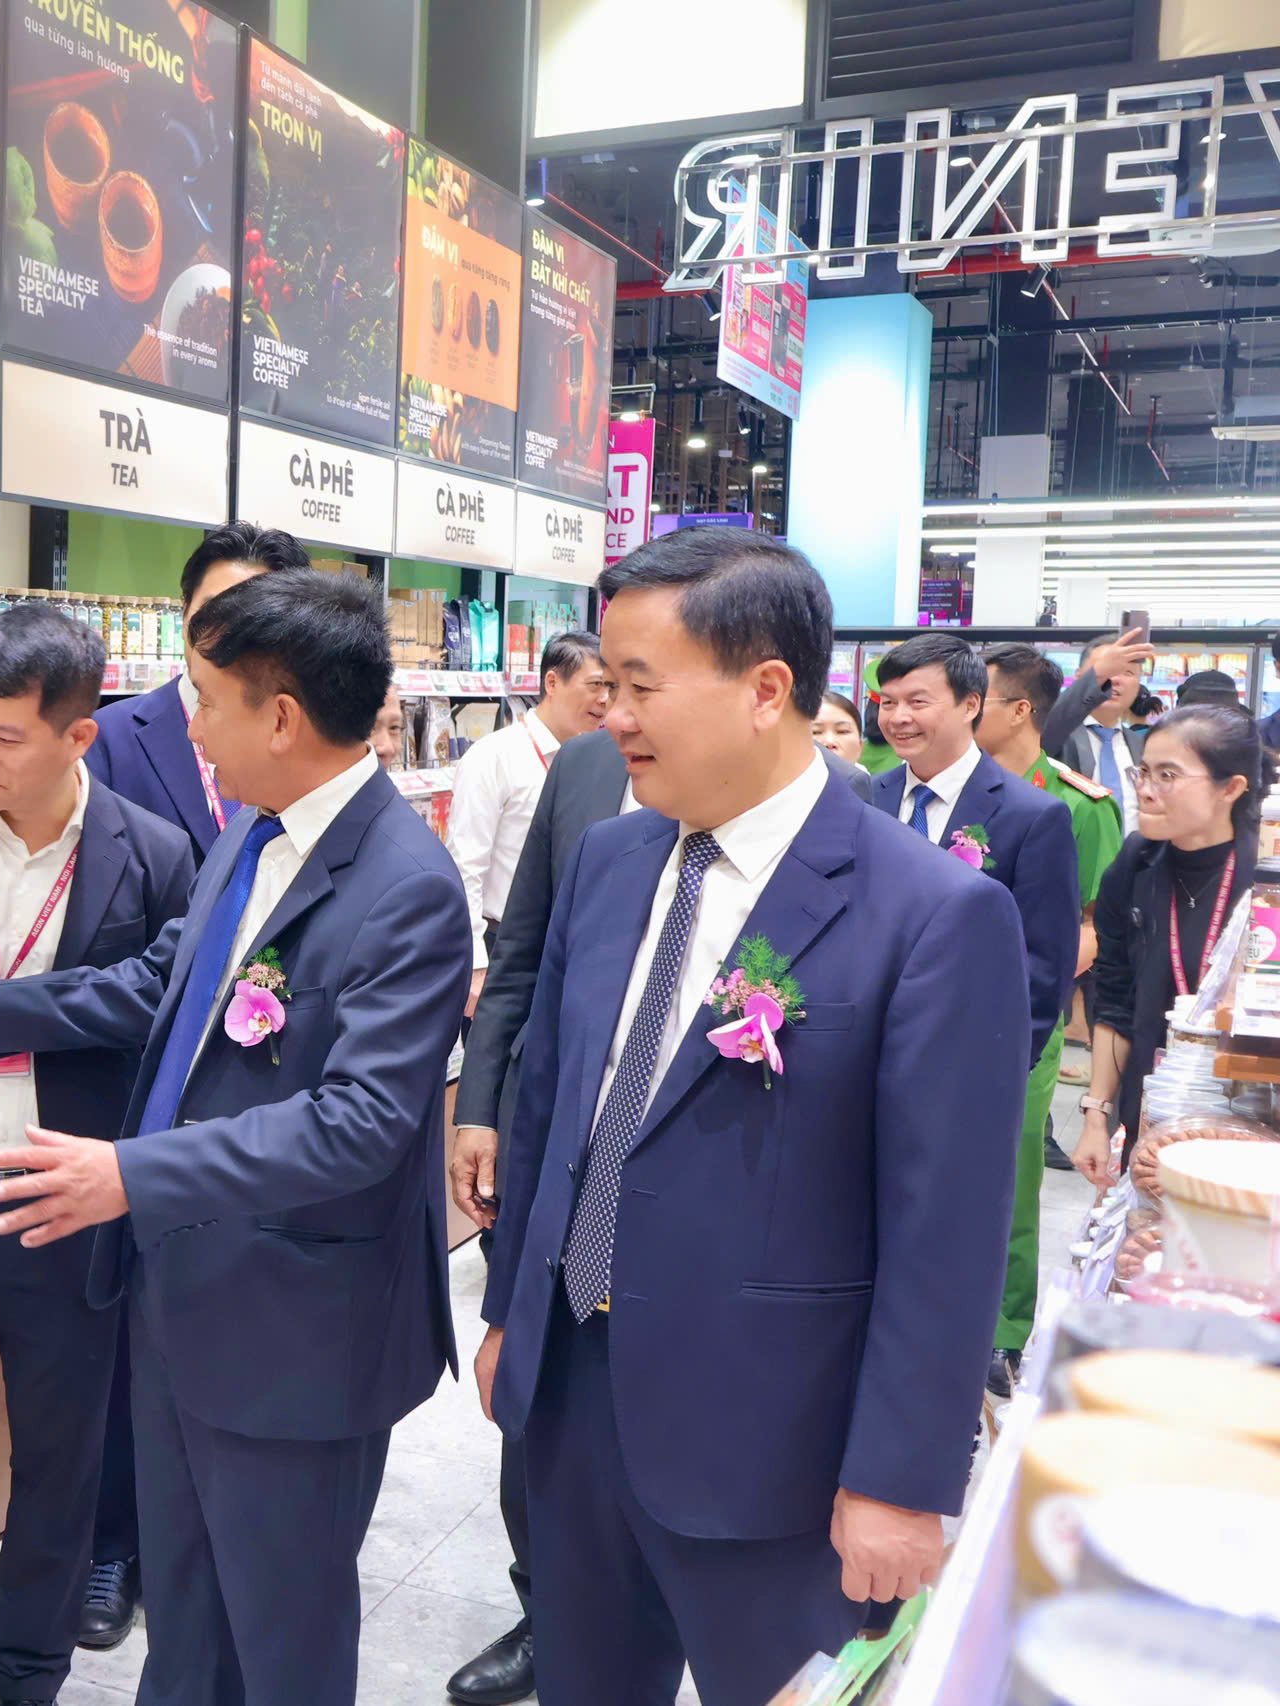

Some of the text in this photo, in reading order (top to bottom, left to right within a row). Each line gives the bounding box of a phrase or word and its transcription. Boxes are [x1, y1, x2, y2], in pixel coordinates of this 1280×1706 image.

[24, 16, 45, 38] qua
[116, 22, 185, 84] THỐNG
[260, 100, 304, 146] TRỌN
[19, 255, 99, 297] VIETNAMESE
[18, 275, 86, 311] SPECIALTY
[19, 294, 44, 318] TEA
[253, 334, 309, 366] VIETNAMESE
[253, 351, 300, 377] SPECIALTY
[253, 367, 289, 389] COFFEE
[410, 394, 448, 418] VIETNAMESE
[99, 407, 152, 455] TRÀ
[407, 421, 432, 439] COFFEE
[408, 408, 441, 431] SPECIALTY
[524, 440, 553, 460] SPECIALTY
[525, 429, 559, 450] VIETNAMESE
[289, 448, 354, 498] CÀ PHÊ
[524, 453, 545, 469] COFFEE
[111, 463, 138, 488] TEA
[302, 498, 341, 523] COFFEE
[436, 482, 485, 523] CÀ PHÊ
[445, 525, 475, 545] COFFEE
[545, 508, 583, 543] CÀ PHÊ
[552, 546, 575, 563] COFFEE
[31, 917, 45, 938] AEON
[41, 902, 54, 919] VIET
[50, 886, 63, 903] NAM
